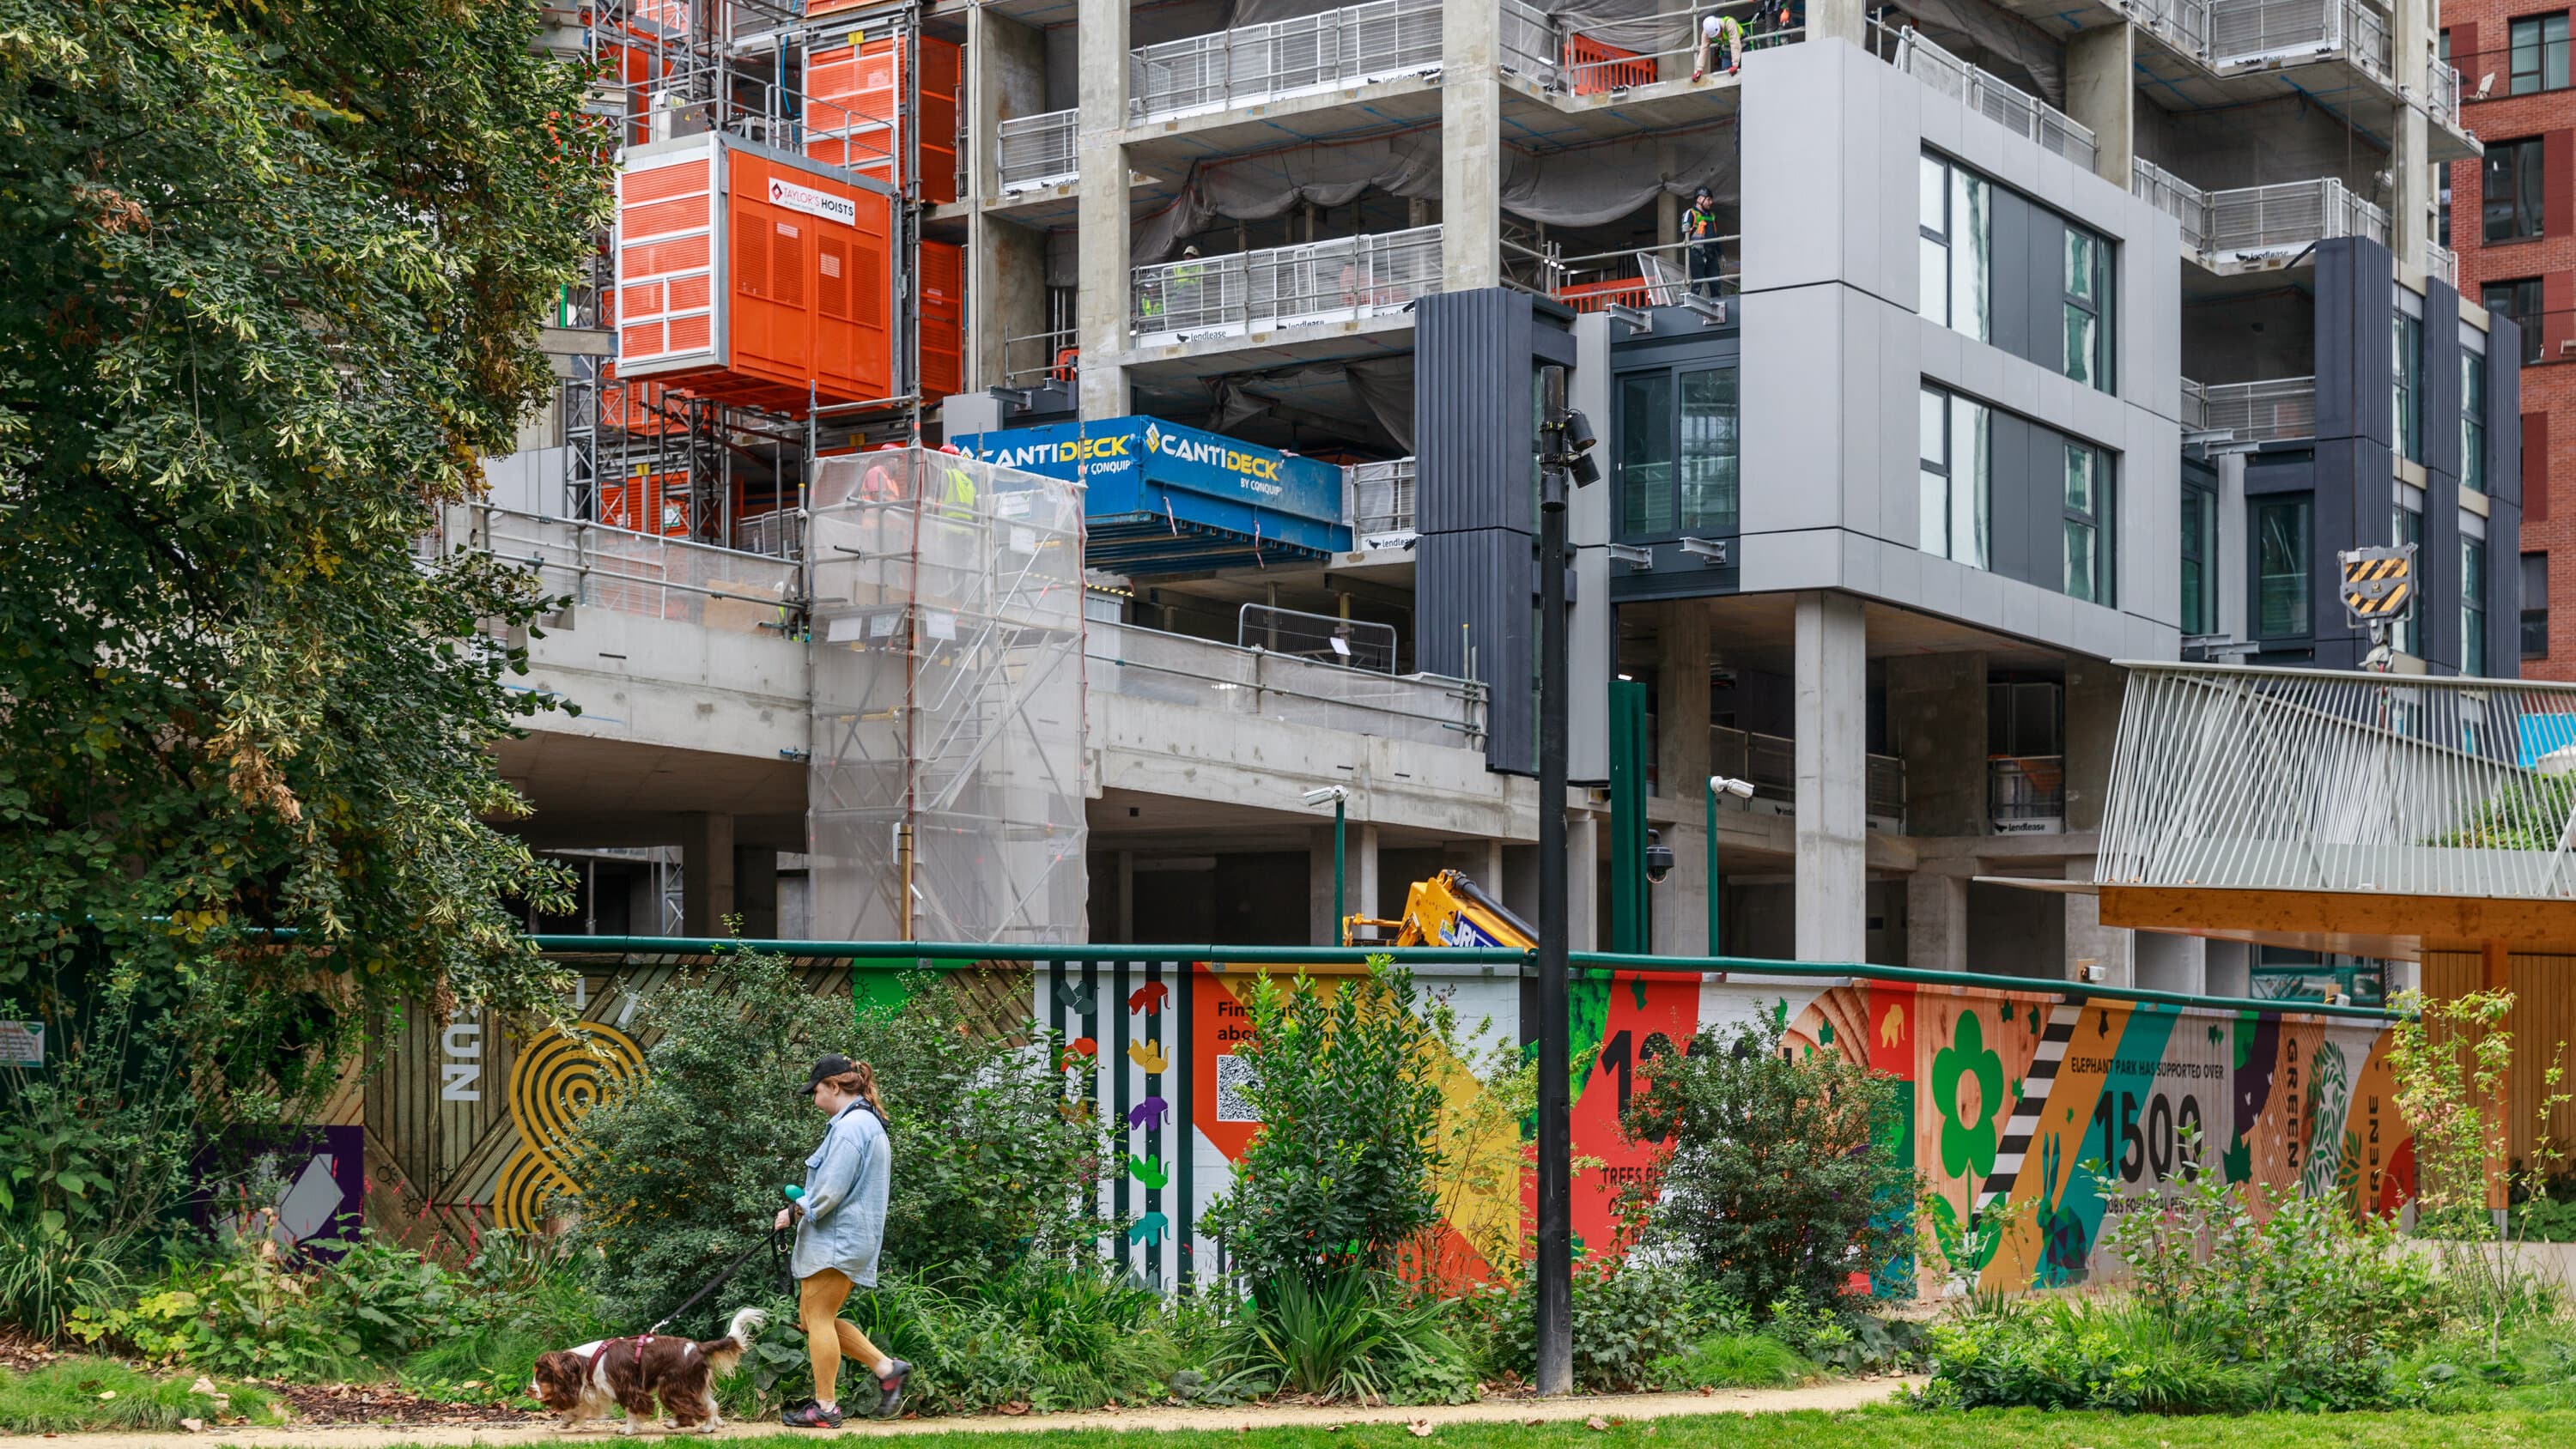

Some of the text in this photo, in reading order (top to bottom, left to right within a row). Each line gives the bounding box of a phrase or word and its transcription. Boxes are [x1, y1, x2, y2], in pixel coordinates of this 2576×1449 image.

[783, 187, 820, 207] TAYLOR'S
[821, 197, 854, 216] HOISTS
[1190, 330, 1226, 342] lendlease
[1091, 459, 1131, 475] CONQUIP
[1161, 434, 1279, 482] CANTIDECK
[1240, 477, 1281, 496] BY CONQUIP
[1382, 537, 1413, 548] lendlea
[2008, 822, 2046, 832] lendlease
[1218, 1025, 1262, 1040] abo
[2071, 1057, 2224, 1079] ELEPHANT PARK HAS SUPPORTED OVER
[2287, 1037, 2299, 1168] GREEN
[2094, 1090, 2202, 1183] 1500
[2368, 1094, 2379, 1214] ERENE
[1602, 1167, 1642, 1186] TREES
